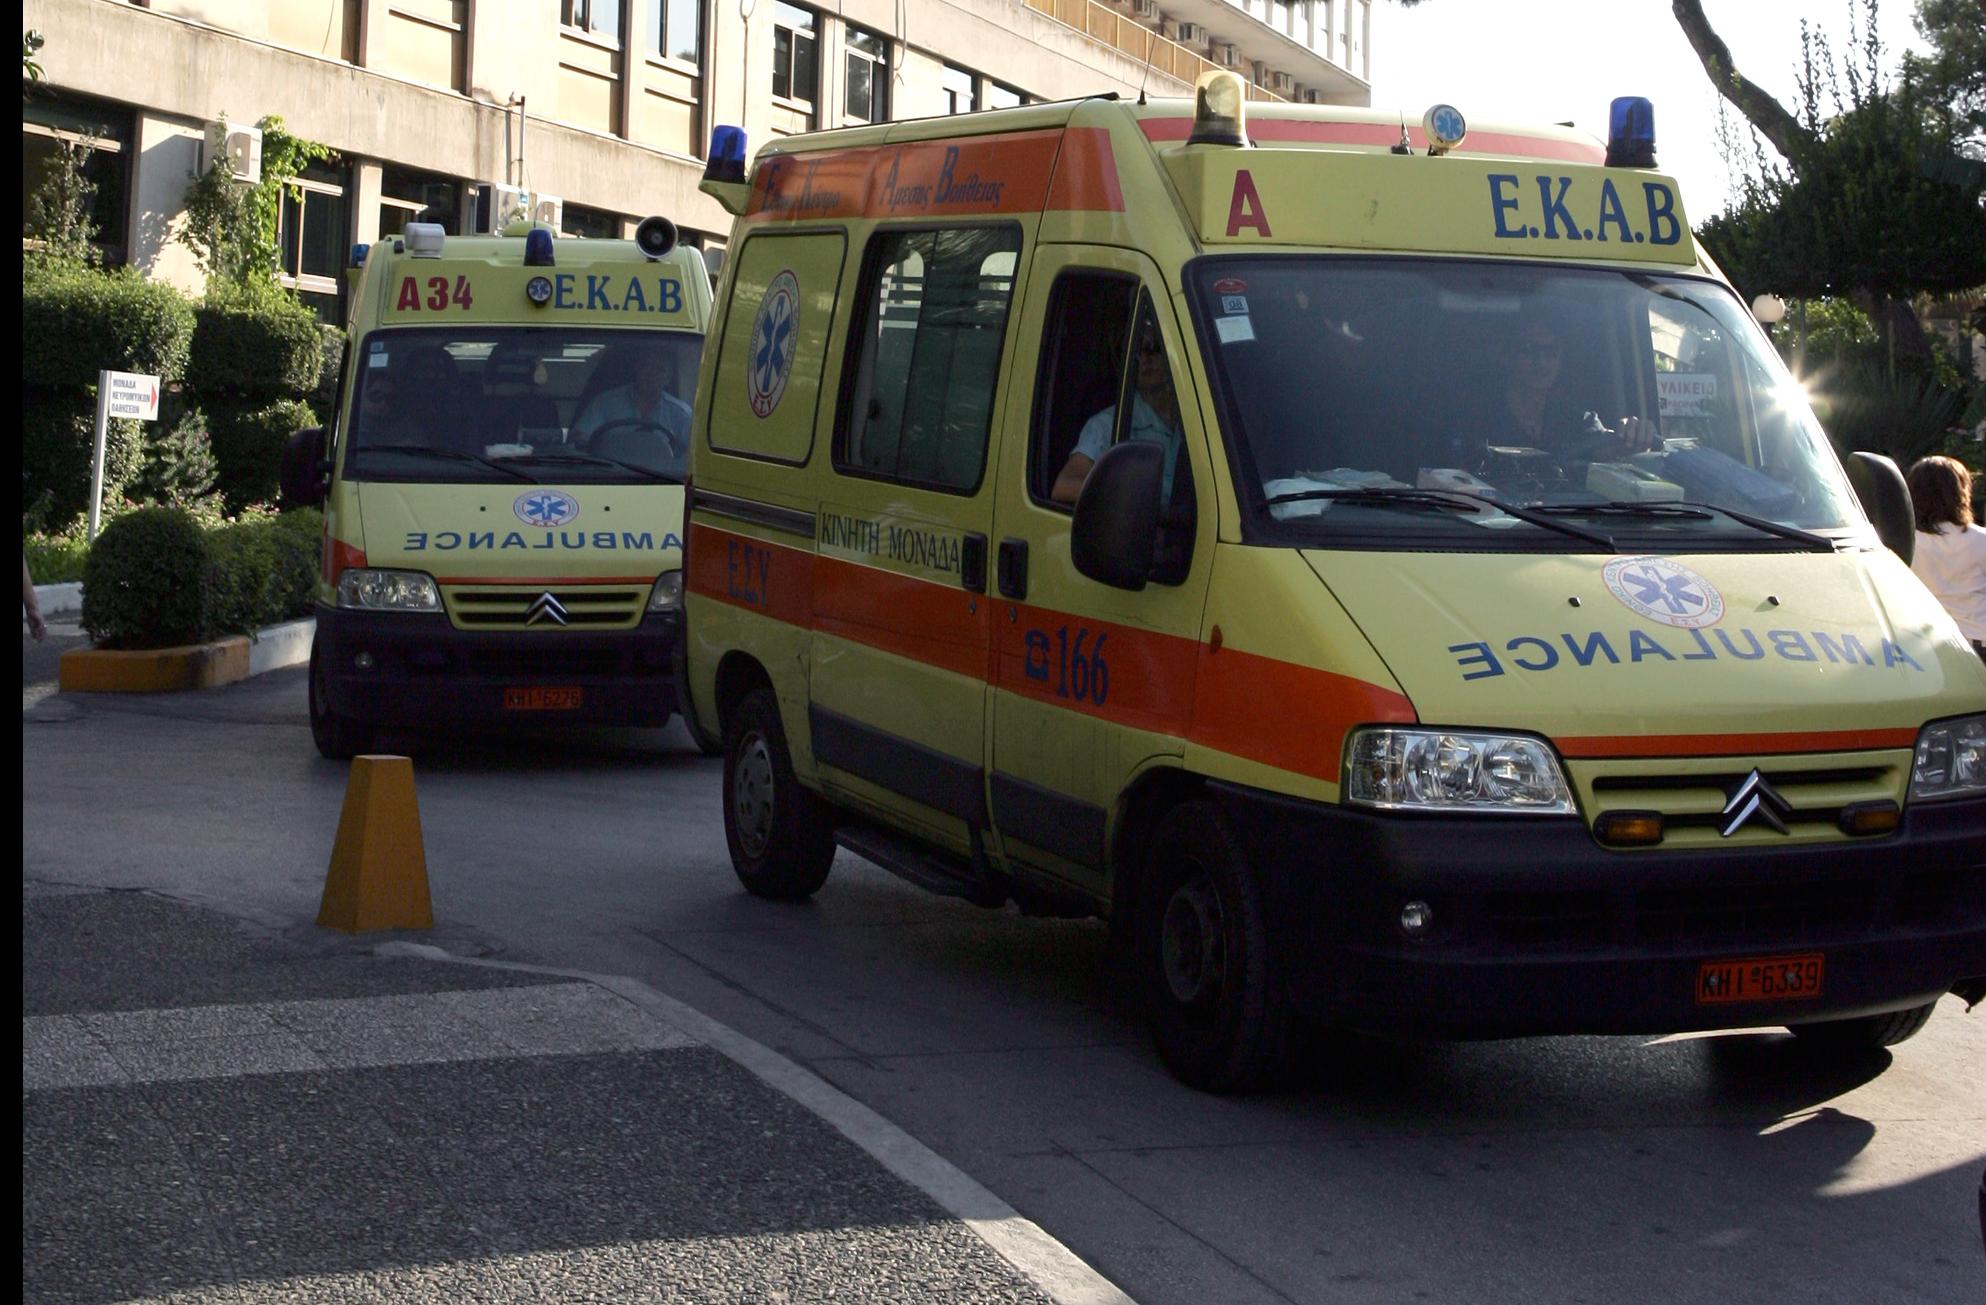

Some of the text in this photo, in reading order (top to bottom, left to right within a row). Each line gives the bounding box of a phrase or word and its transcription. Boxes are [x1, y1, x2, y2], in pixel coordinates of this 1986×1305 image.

[1226, 170, 1272, 237] Α
[820, 512, 961, 574] ΚΙΝΗΤΗ ΜΟΝΑΔΑ
[1056, 624, 1108, 706] 166
